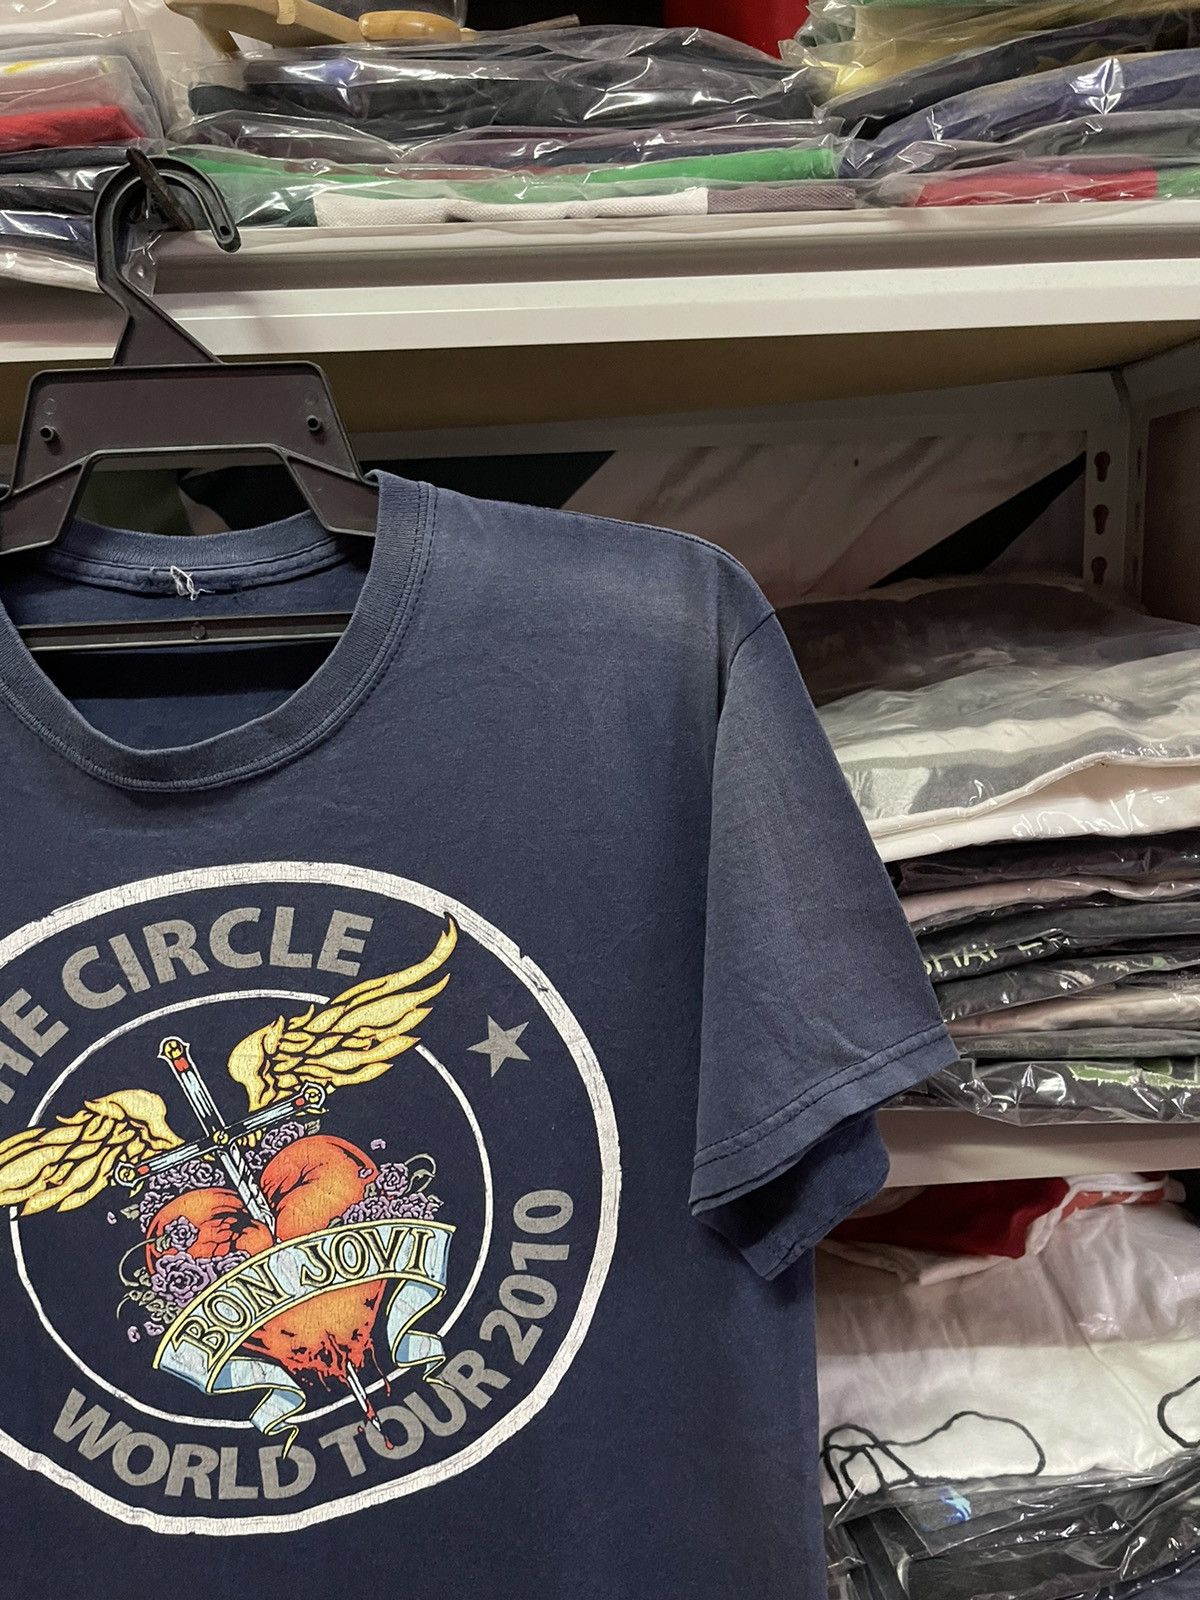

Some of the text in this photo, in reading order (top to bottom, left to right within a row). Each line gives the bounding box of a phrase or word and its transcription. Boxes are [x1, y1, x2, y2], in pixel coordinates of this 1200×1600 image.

[0, 906, 374, 1105] HE CIRCLE
[53, 1189, 574, 1500] WORLD TOUR 2010
[173, 1228, 433, 1370] BON JOVI
